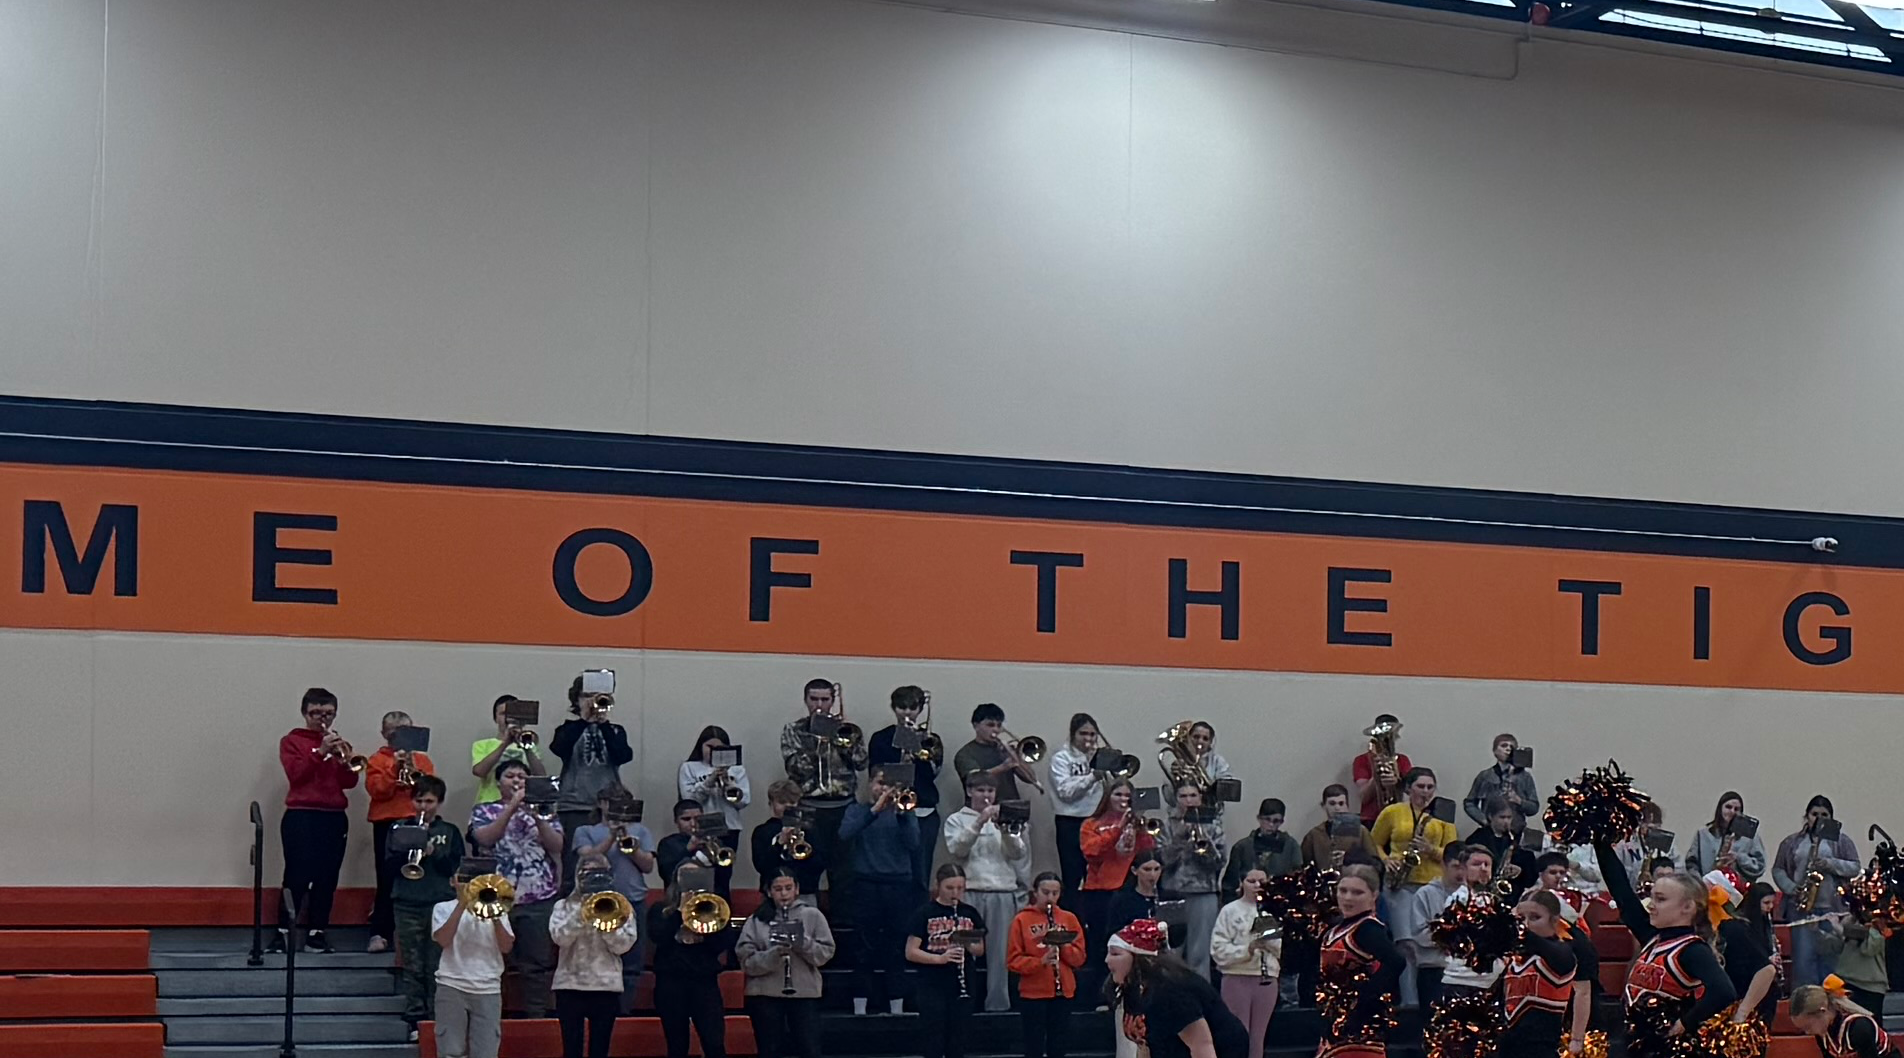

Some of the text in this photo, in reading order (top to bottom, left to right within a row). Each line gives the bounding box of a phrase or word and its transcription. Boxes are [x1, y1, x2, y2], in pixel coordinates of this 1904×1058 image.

[22, 500, 338, 605] ME
[553, 528, 819, 622] OF
[1010, 550, 1392, 647] THE
